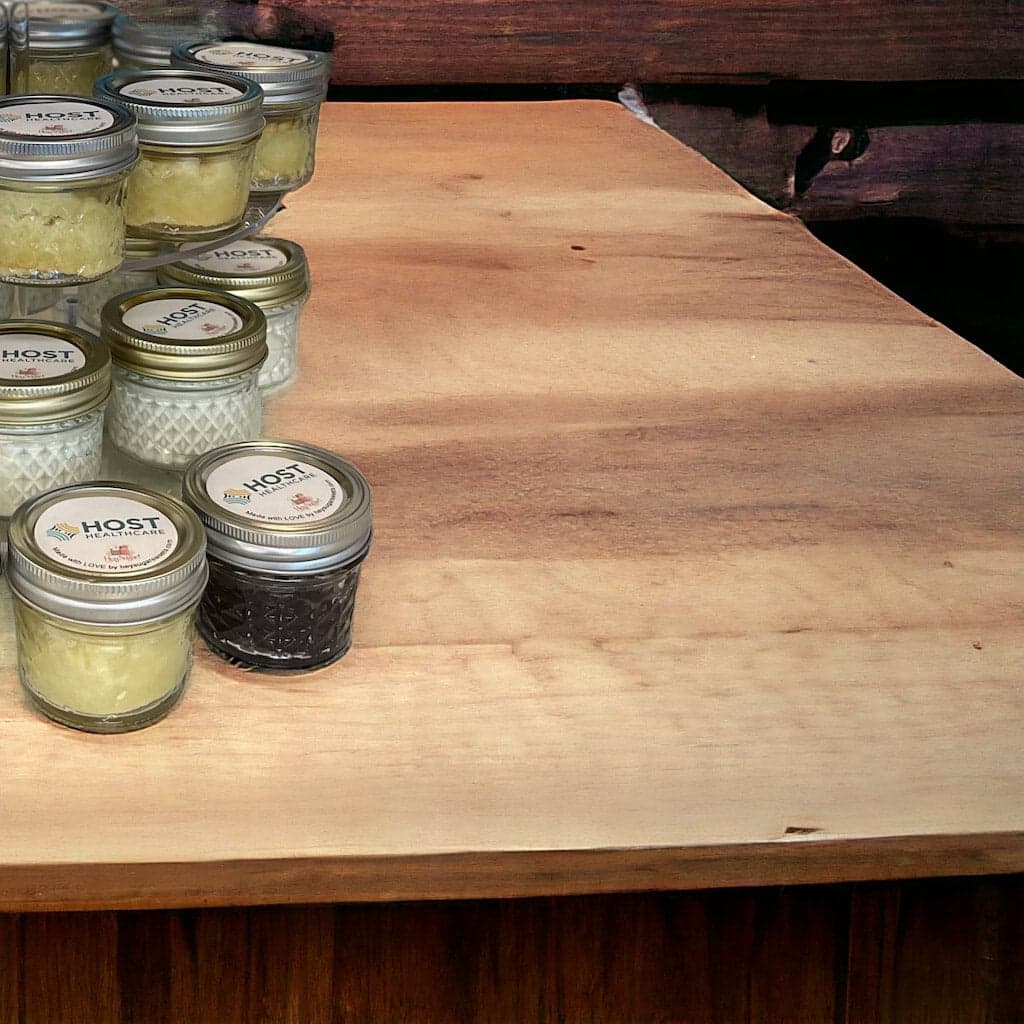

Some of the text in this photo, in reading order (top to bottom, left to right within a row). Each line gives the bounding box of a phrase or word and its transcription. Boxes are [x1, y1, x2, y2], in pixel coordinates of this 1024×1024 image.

[24, 110, 100, 119] HOST
[214, 249, 273, 257] HOST
[157, 303, 207, 326] HOST
[2, 349, 75, 360] HOST
[242, 464, 307, 493] HOST
[258, 473, 315, 497] HEALTHCARE
[82, 517, 160, 533] HOST
[85, 528, 166, 539] HEALTHCARE
